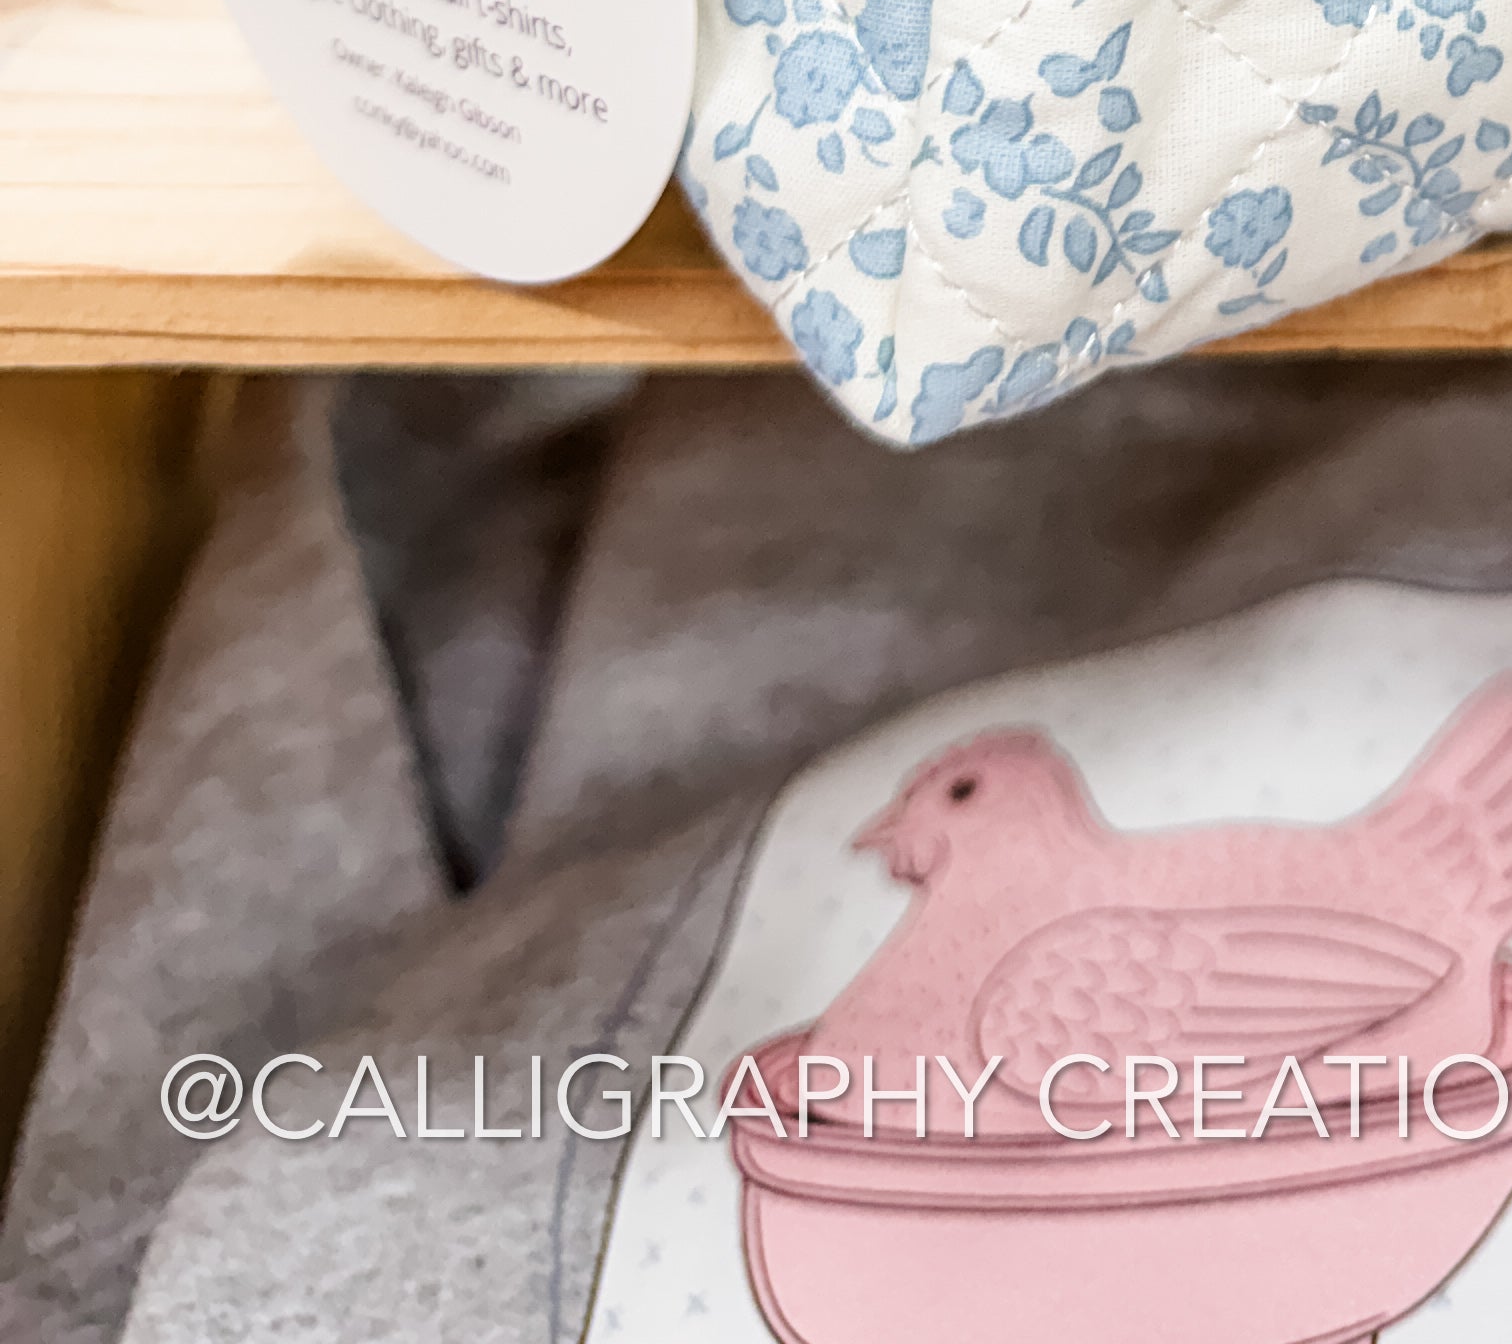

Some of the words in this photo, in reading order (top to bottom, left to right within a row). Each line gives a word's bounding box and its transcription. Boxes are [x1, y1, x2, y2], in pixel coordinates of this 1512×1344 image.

[453, 34, 503, 78] gifts
[511, 55, 530, 88] &
[538, 71, 608, 124] more
